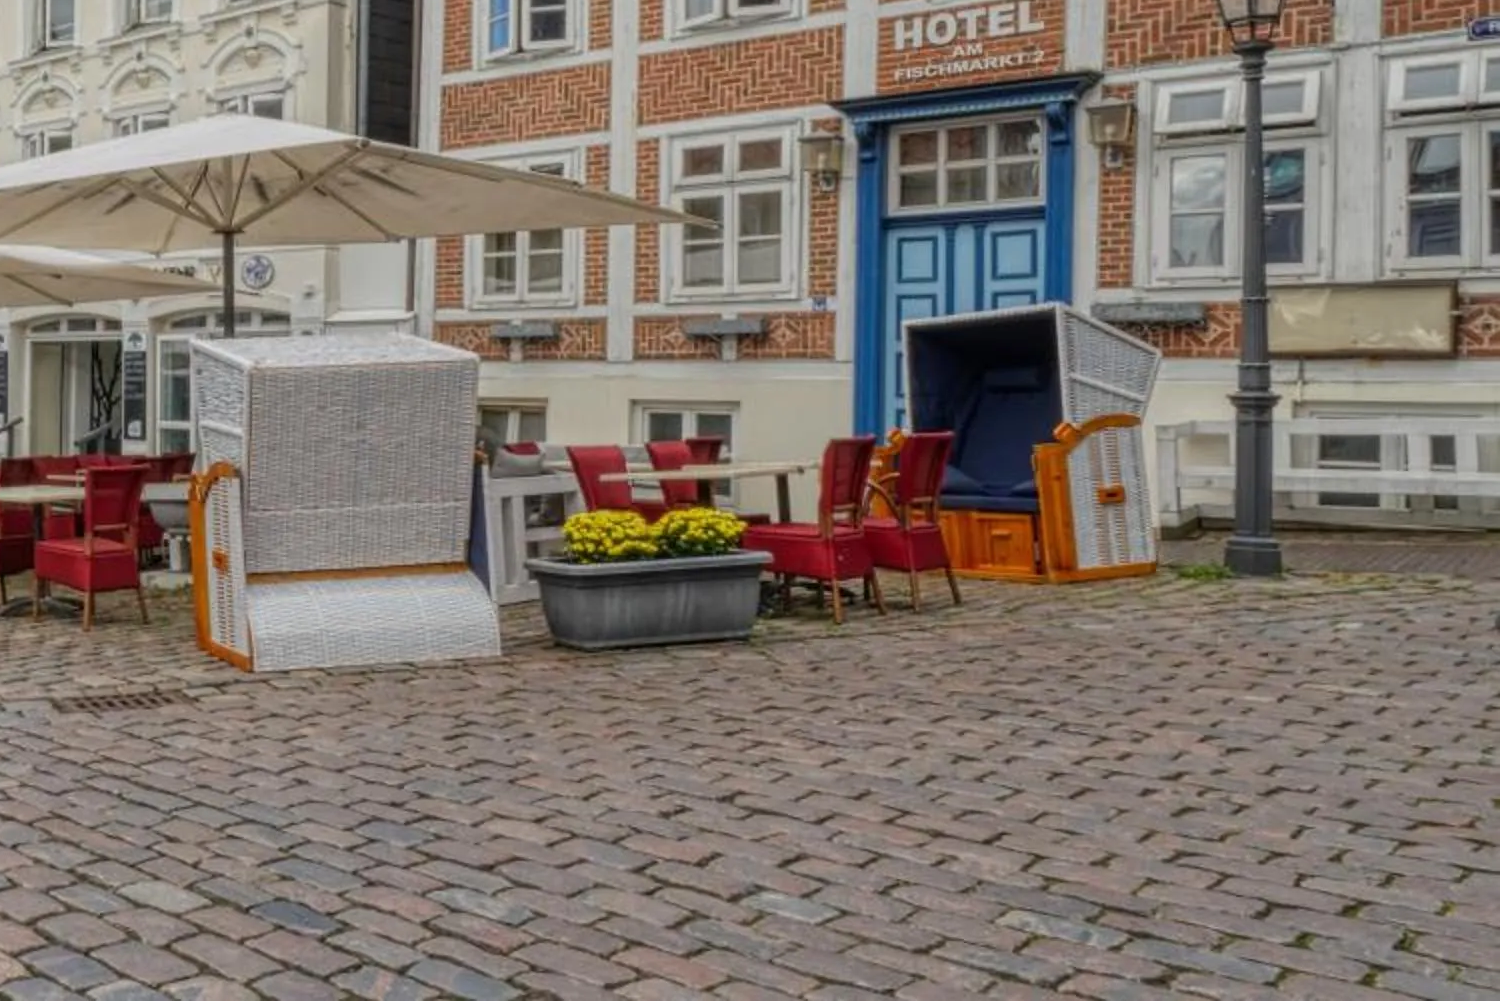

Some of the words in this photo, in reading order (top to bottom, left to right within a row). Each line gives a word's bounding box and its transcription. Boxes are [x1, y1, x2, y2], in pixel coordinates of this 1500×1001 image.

[894, 0, 1045, 50] HOTEL
[952, 42, 984, 58] AM
[894, 52, 1029, 81] FISCHMARKT
